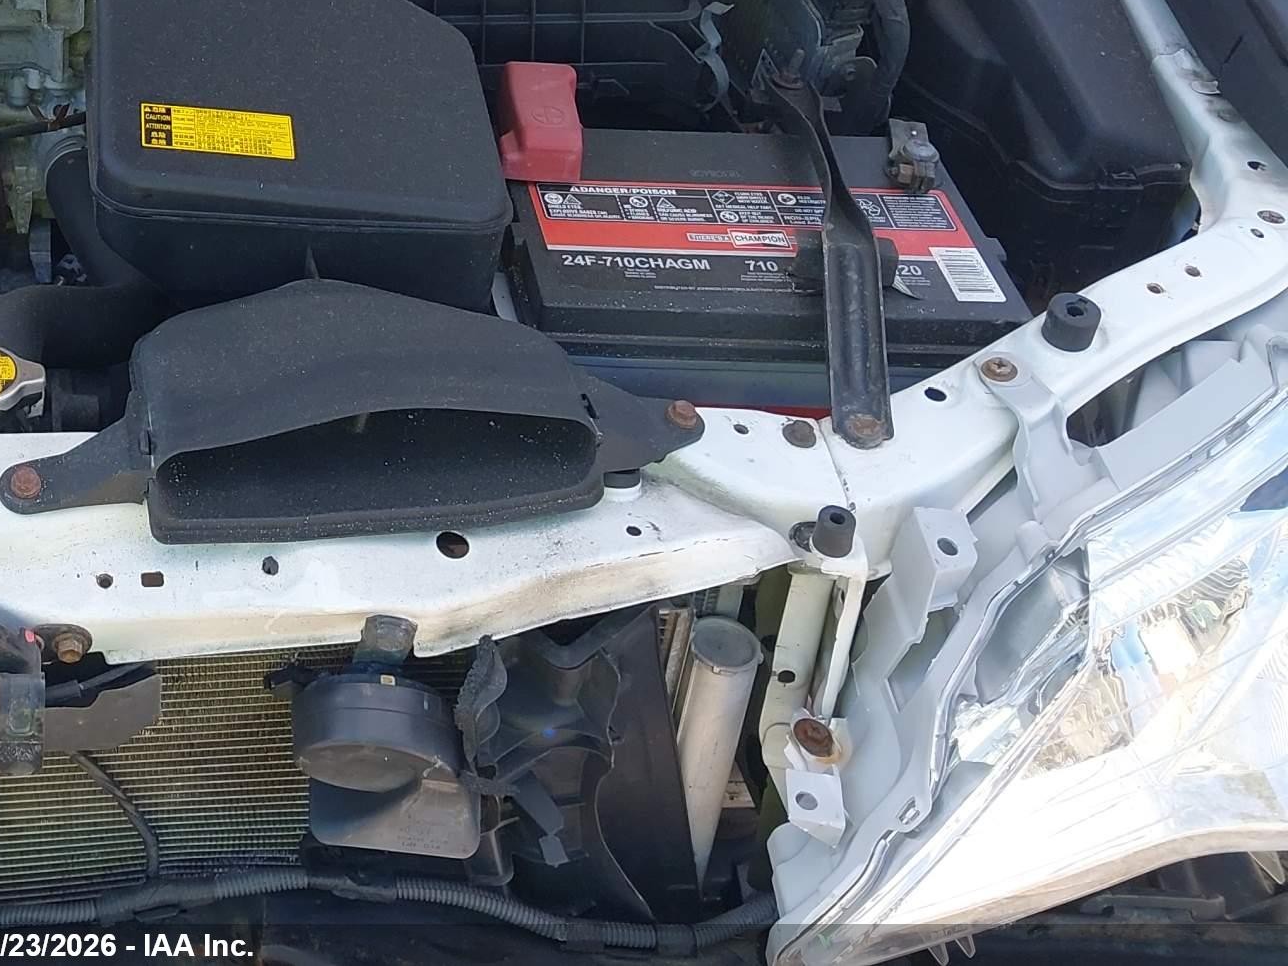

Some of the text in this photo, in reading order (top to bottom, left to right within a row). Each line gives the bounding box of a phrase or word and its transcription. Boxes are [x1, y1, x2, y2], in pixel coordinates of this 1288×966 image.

[145, 113, 171, 122] CAUTION
[734, 234, 785, 244] CHAMPION
[561, 254, 711, 270] 24F-710CHAGM
[745, 260, 779, 272] 710
[896, 265, 922, 276] 20
